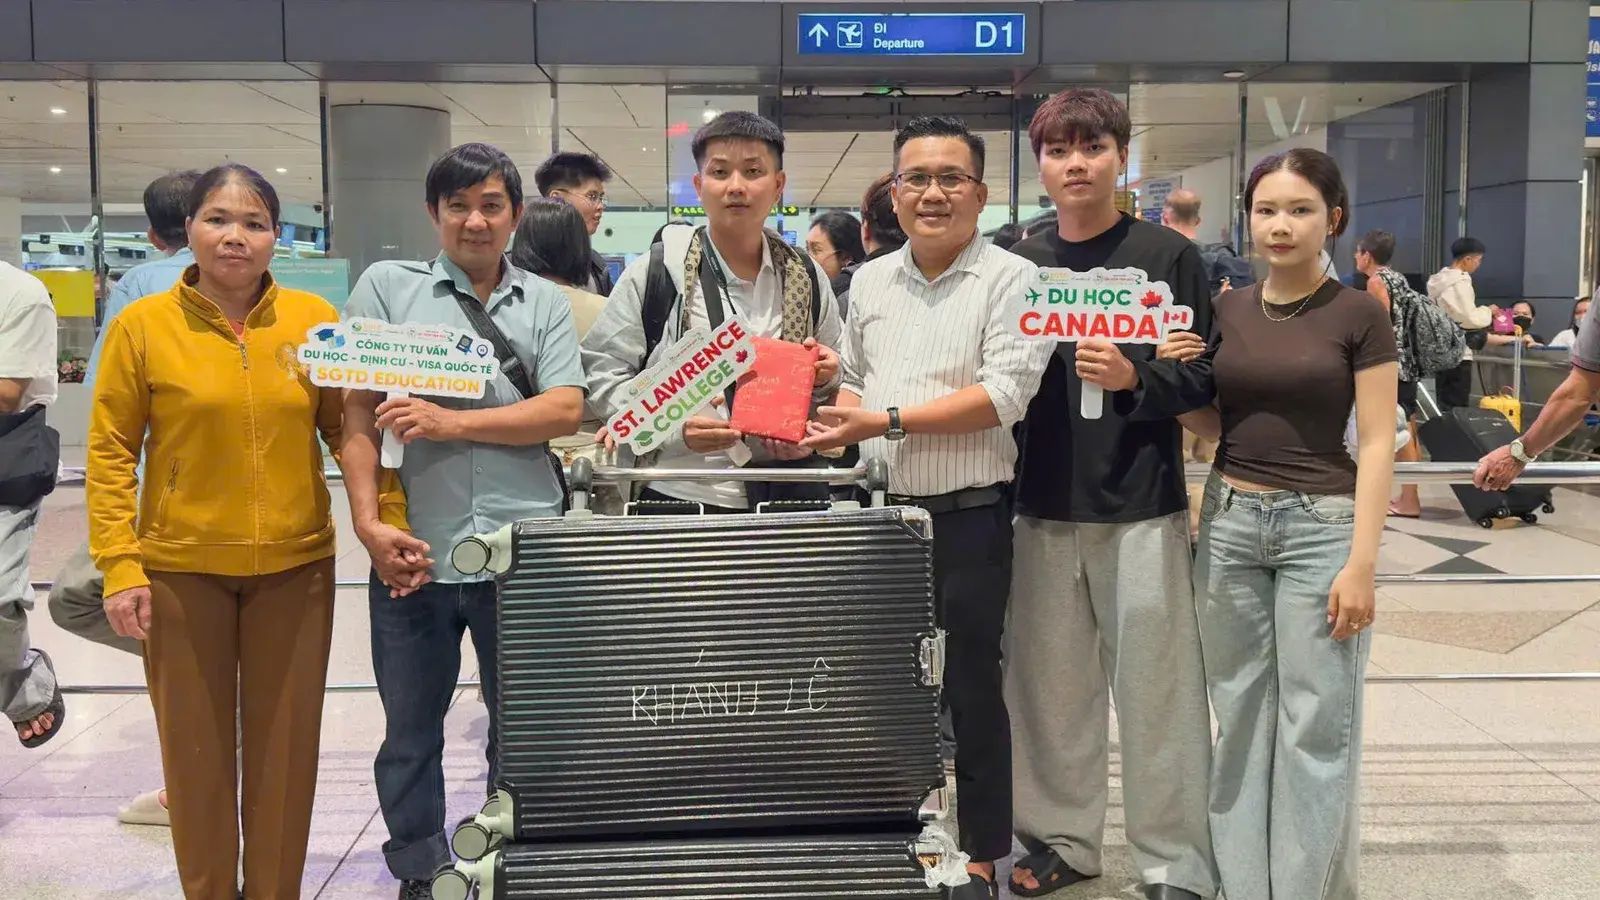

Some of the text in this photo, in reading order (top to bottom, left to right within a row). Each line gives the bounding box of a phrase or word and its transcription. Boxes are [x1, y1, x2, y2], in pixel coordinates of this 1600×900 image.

[874, 23, 887, 33] ĐI
[975, 21, 1013, 48] D1
[873, 38, 925, 50] Departure
[1047, 288, 1132, 311] DU HỌC
[1019, 311, 1159, 339] CANADA
[356, 339, 448, 356] CÔNG TY TƯ VẤN
[304, 350, 320, 359] DU
[323, 351, 348, 364] HỌC
[360, 355, 387, 366] ĐỊNH
[390, 356, 408, 367] CƯ
[417, 360, 442, 370] VISA
[444, 361, 477, 373] QUỐC
[480, 362, 492, 375] TẾ
[317, 366, 480, 393] SGTD EDUCATION
[613, 409, 645, 438] ST.
[641, 321, 746, 415] LAWRENCE
[653, 359, 735, 432] COLLEGE
[632, 649, 830, 726] KHÁNH LÊ
